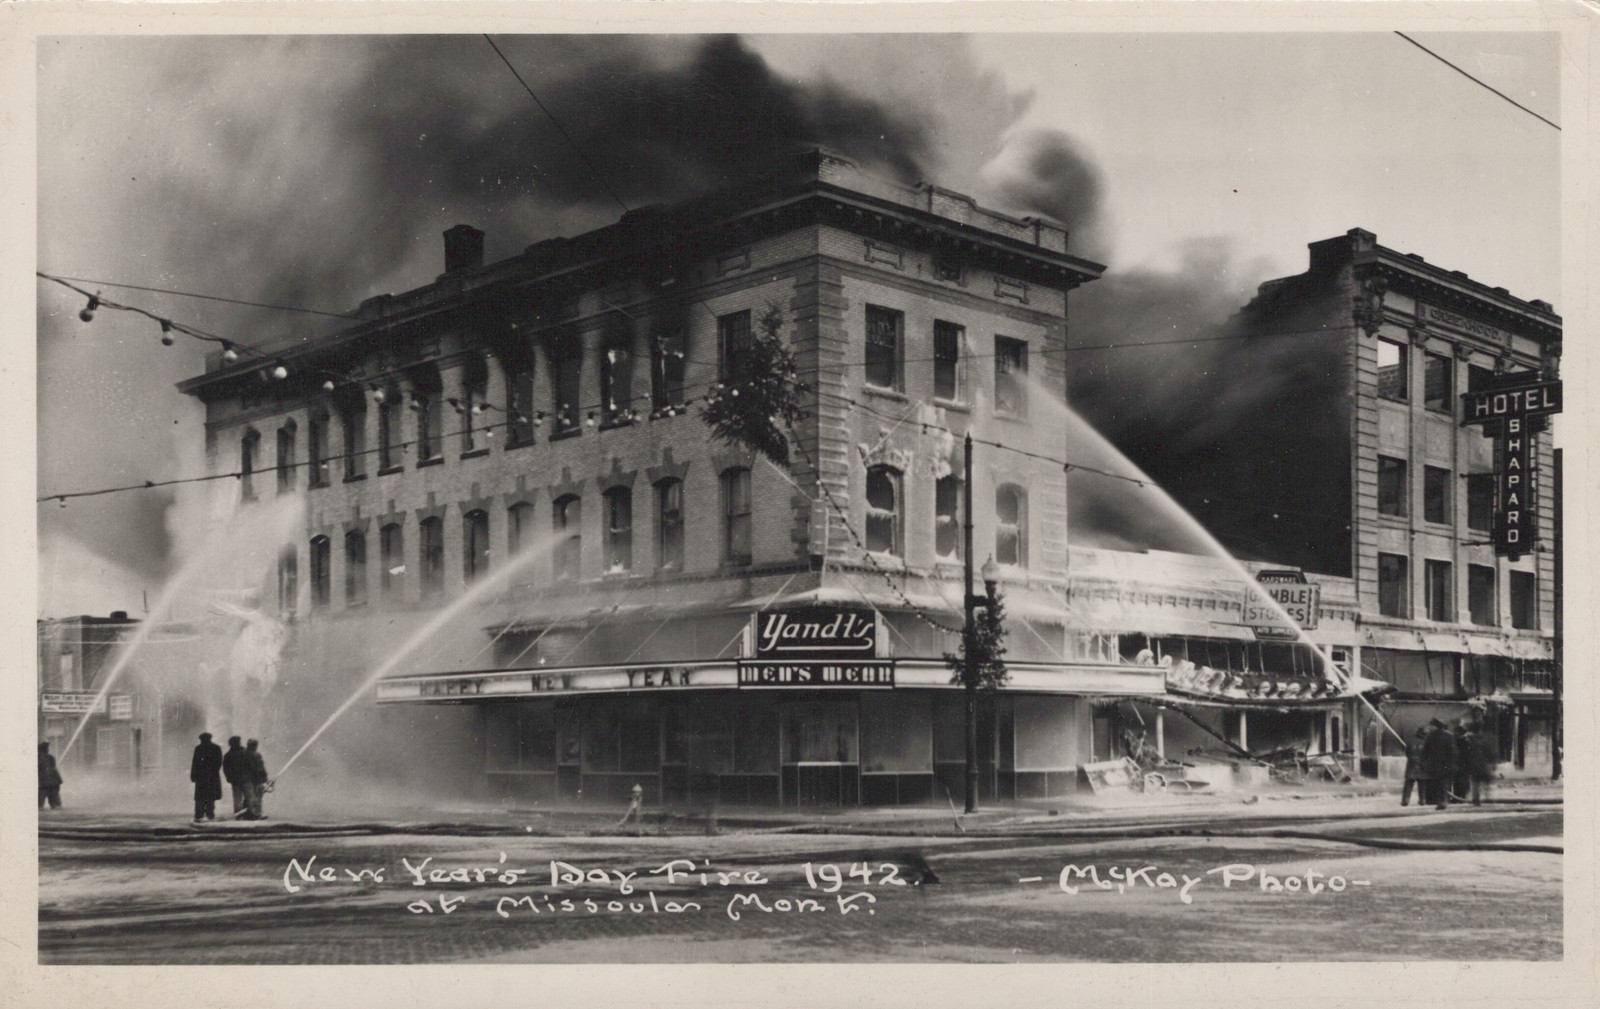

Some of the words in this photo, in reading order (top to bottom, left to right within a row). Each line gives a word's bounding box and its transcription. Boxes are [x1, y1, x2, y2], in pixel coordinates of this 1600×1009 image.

[1475, 387, 1556, 417] HOTEL
[1507, 419, 1521, 543] SHAPARD
[1249, 588, 1307, 604] GMBLE
[1249, 607, 1305, 622] STOES
[626, 667, 691, 689] YEAR
[741, 666, 811, 682] MEN'S
[822, 666, 891, 682] WEAR
